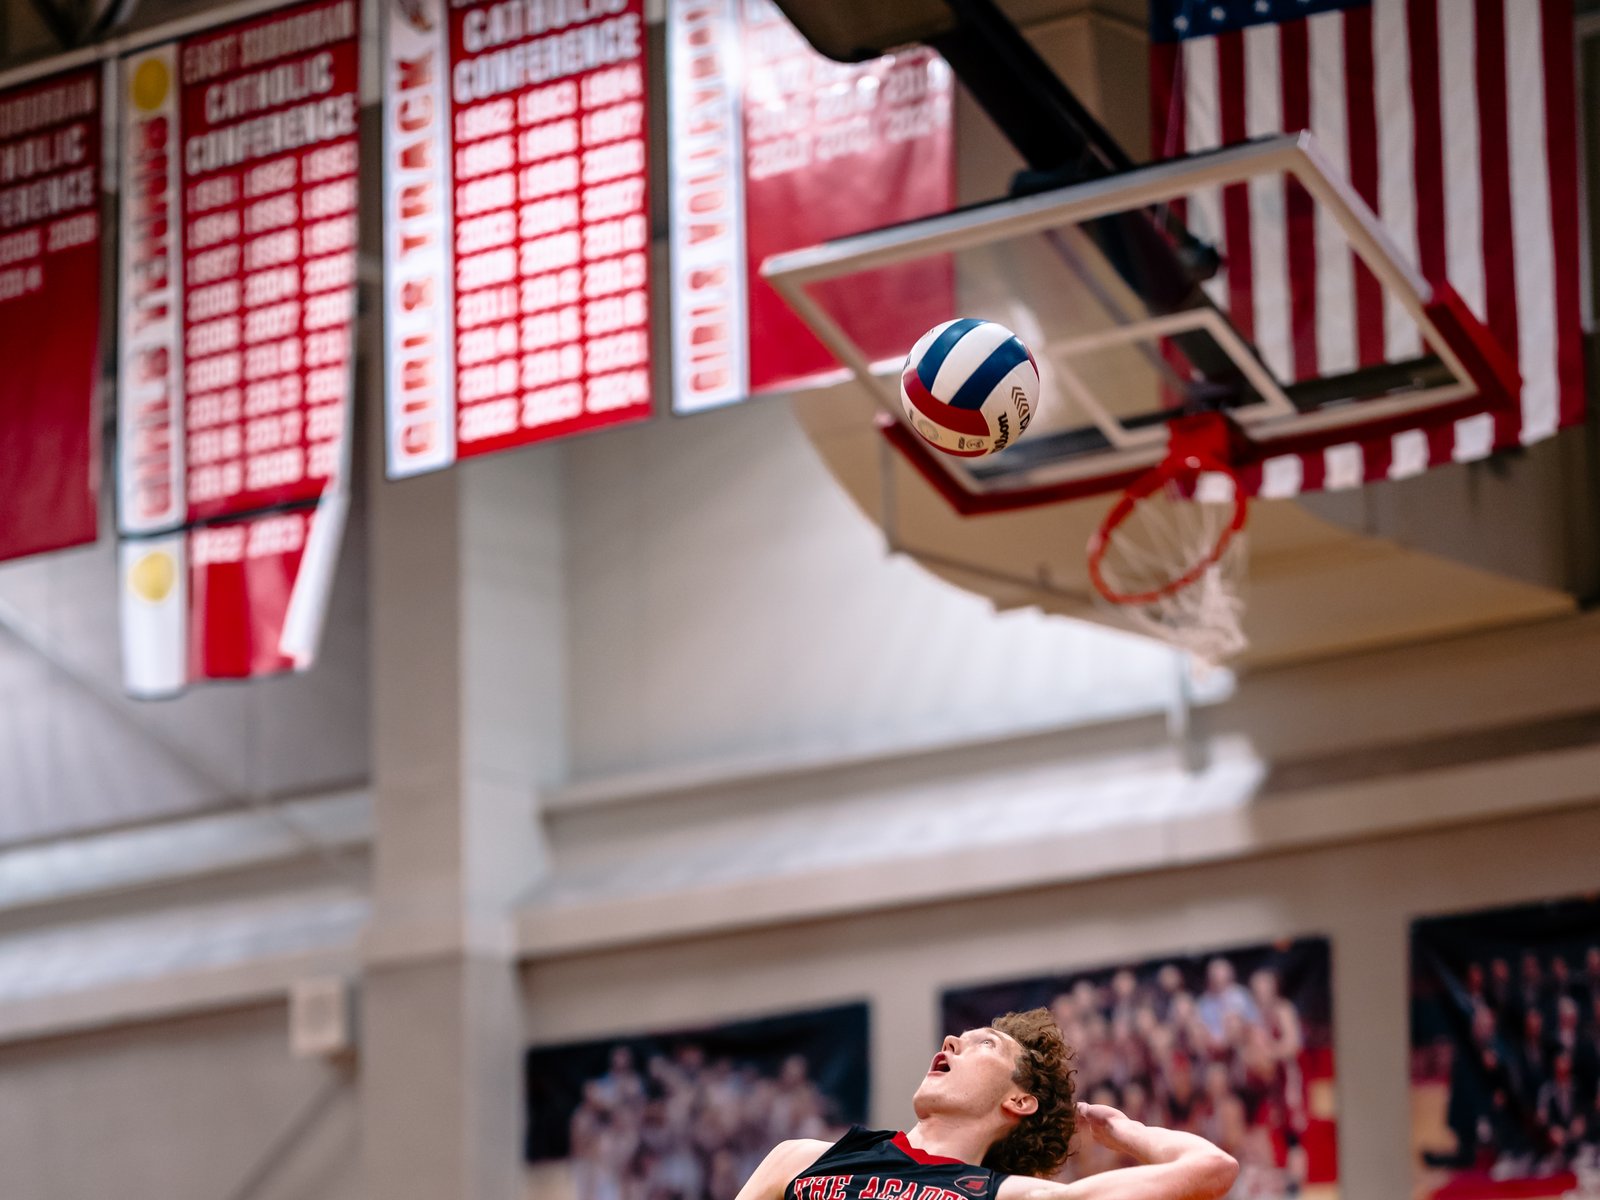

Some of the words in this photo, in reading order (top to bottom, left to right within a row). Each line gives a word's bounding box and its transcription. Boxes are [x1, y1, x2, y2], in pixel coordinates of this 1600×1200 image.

[463, 0, 629, 53] CATHOL
[205, 52, 334, 124] CATHOLIC
[185, 93, 357, 177] CONFERENCE
